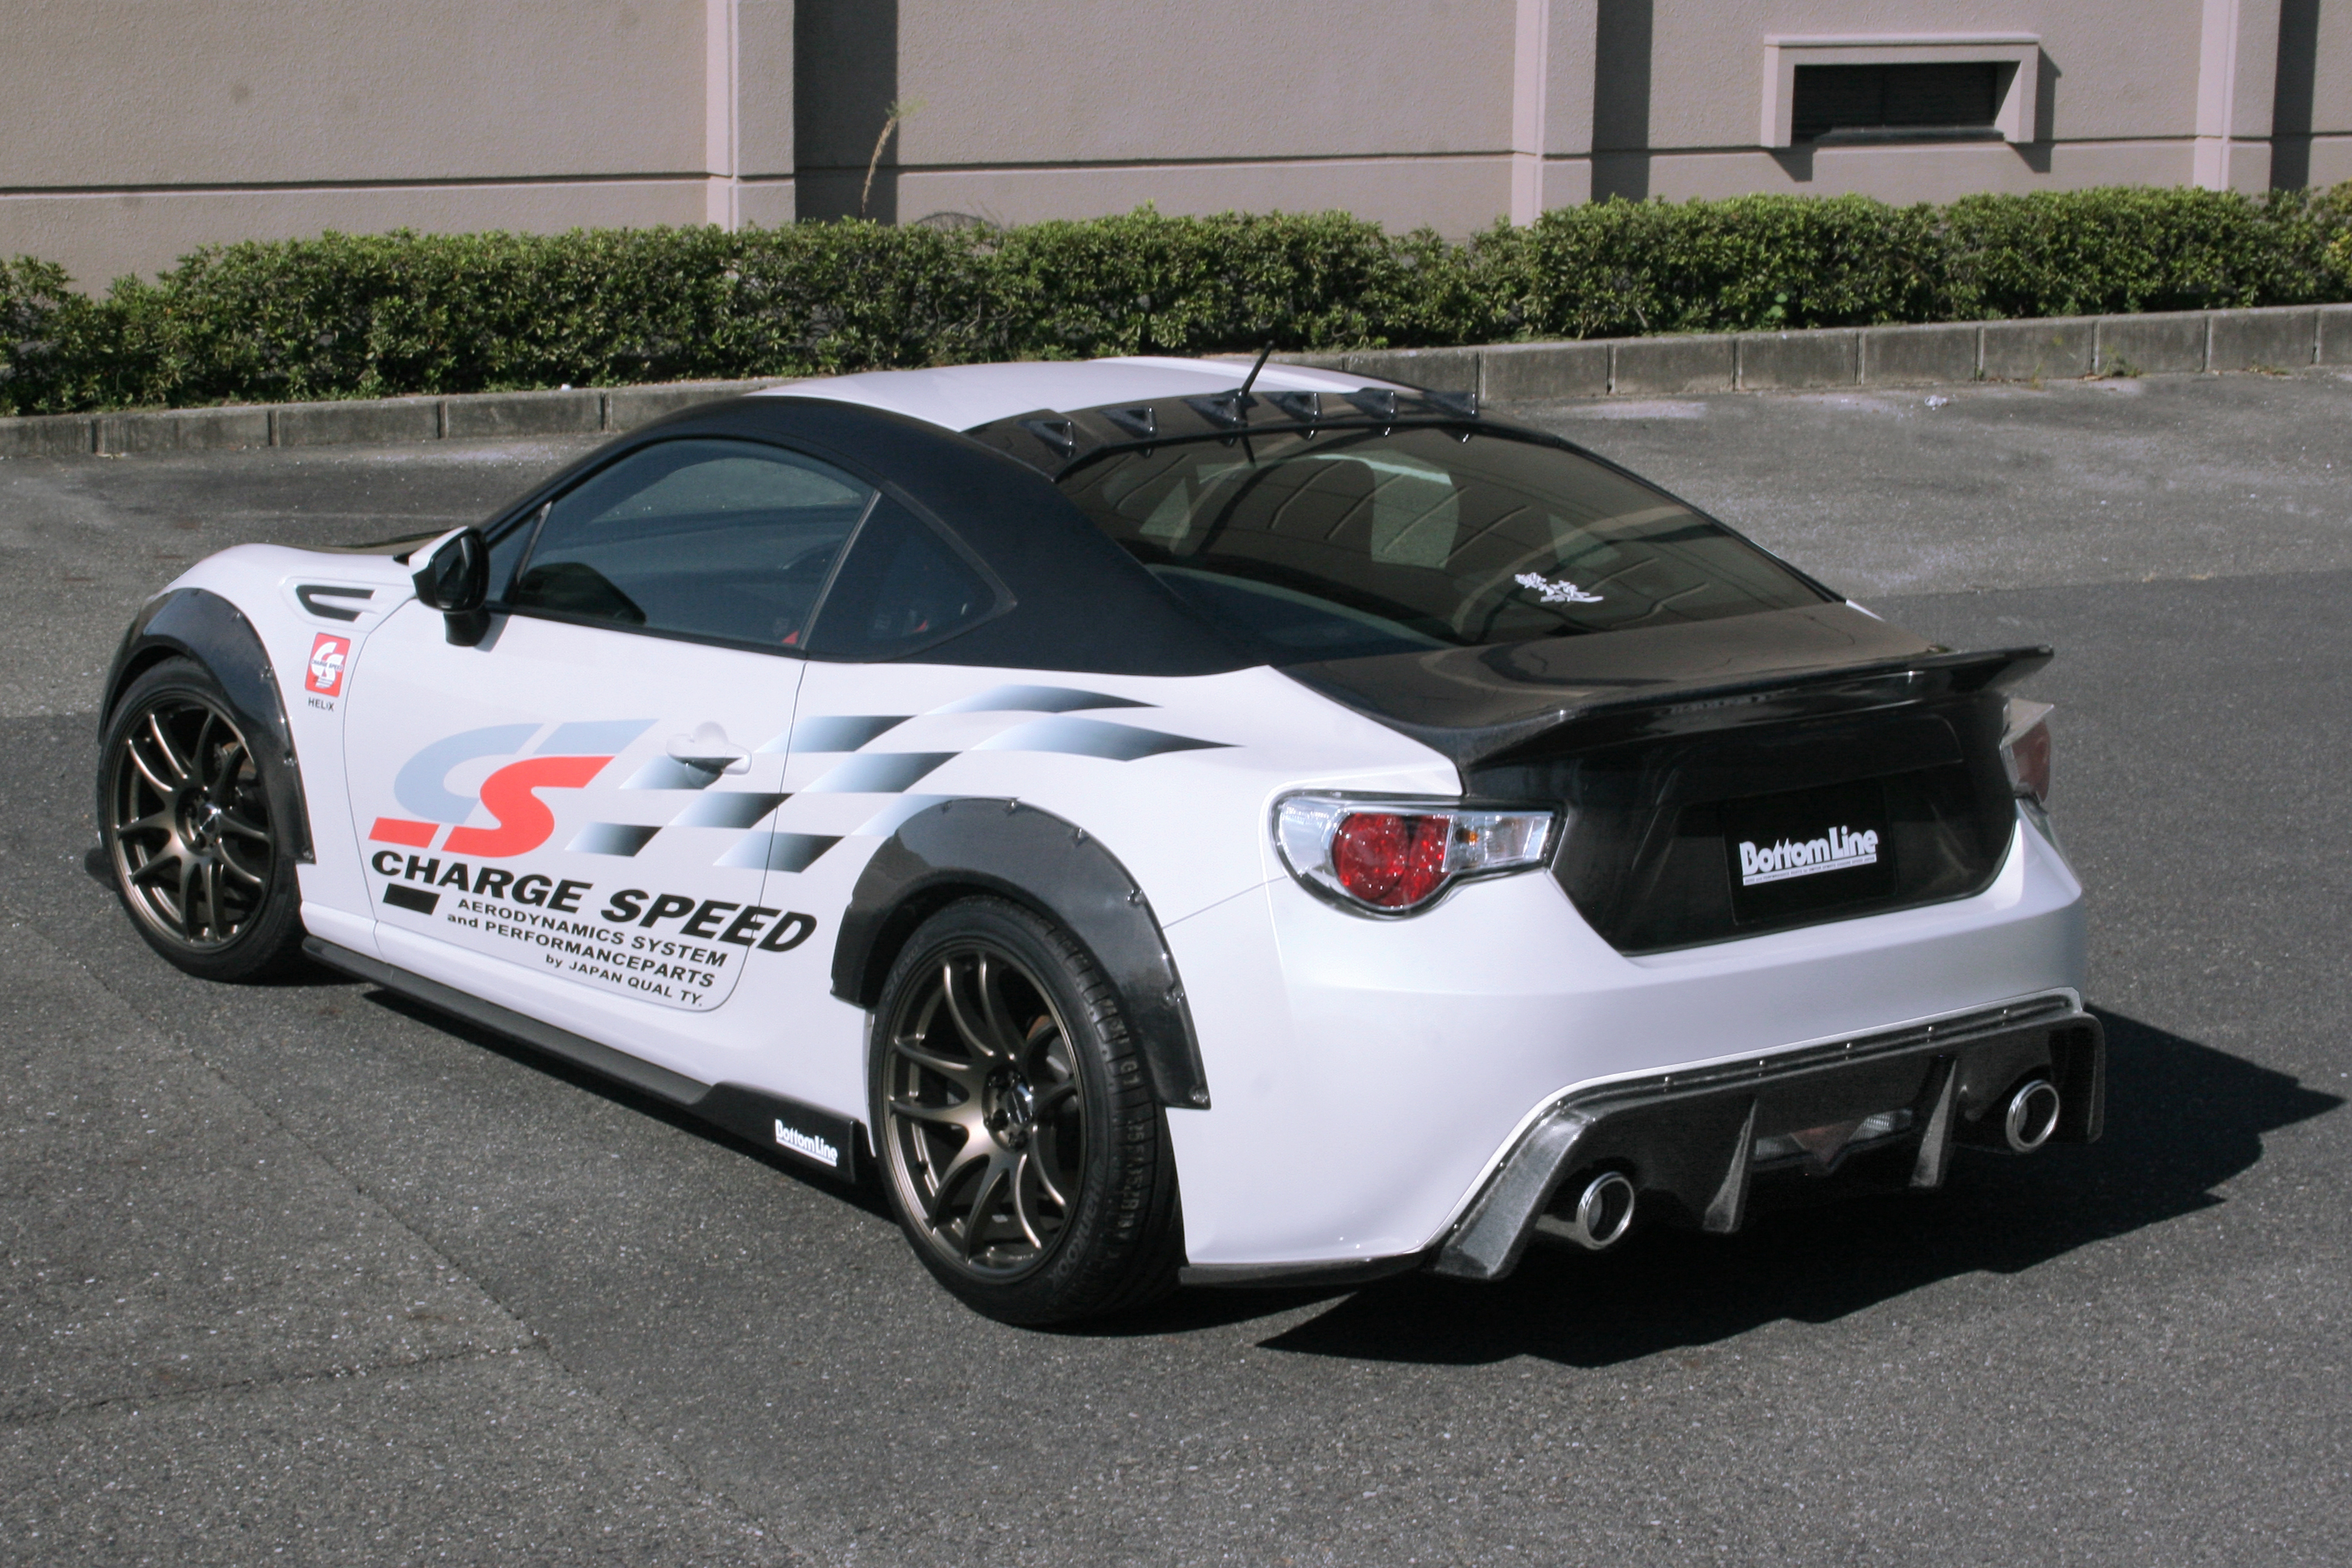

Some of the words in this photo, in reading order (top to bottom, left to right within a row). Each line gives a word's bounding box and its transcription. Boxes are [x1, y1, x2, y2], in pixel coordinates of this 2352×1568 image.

[371, 850, 593, 914] CHARGE
[601, 888, 817, 952] SPEED
[447, 912, 479, 928] and
[458, 898, 624, 944] AERODYNAMICS
[631, 936, 728, 968] SYSTEM
[546, 953, 563, 968] by
[569, 961, 622, 983] JAPAN
